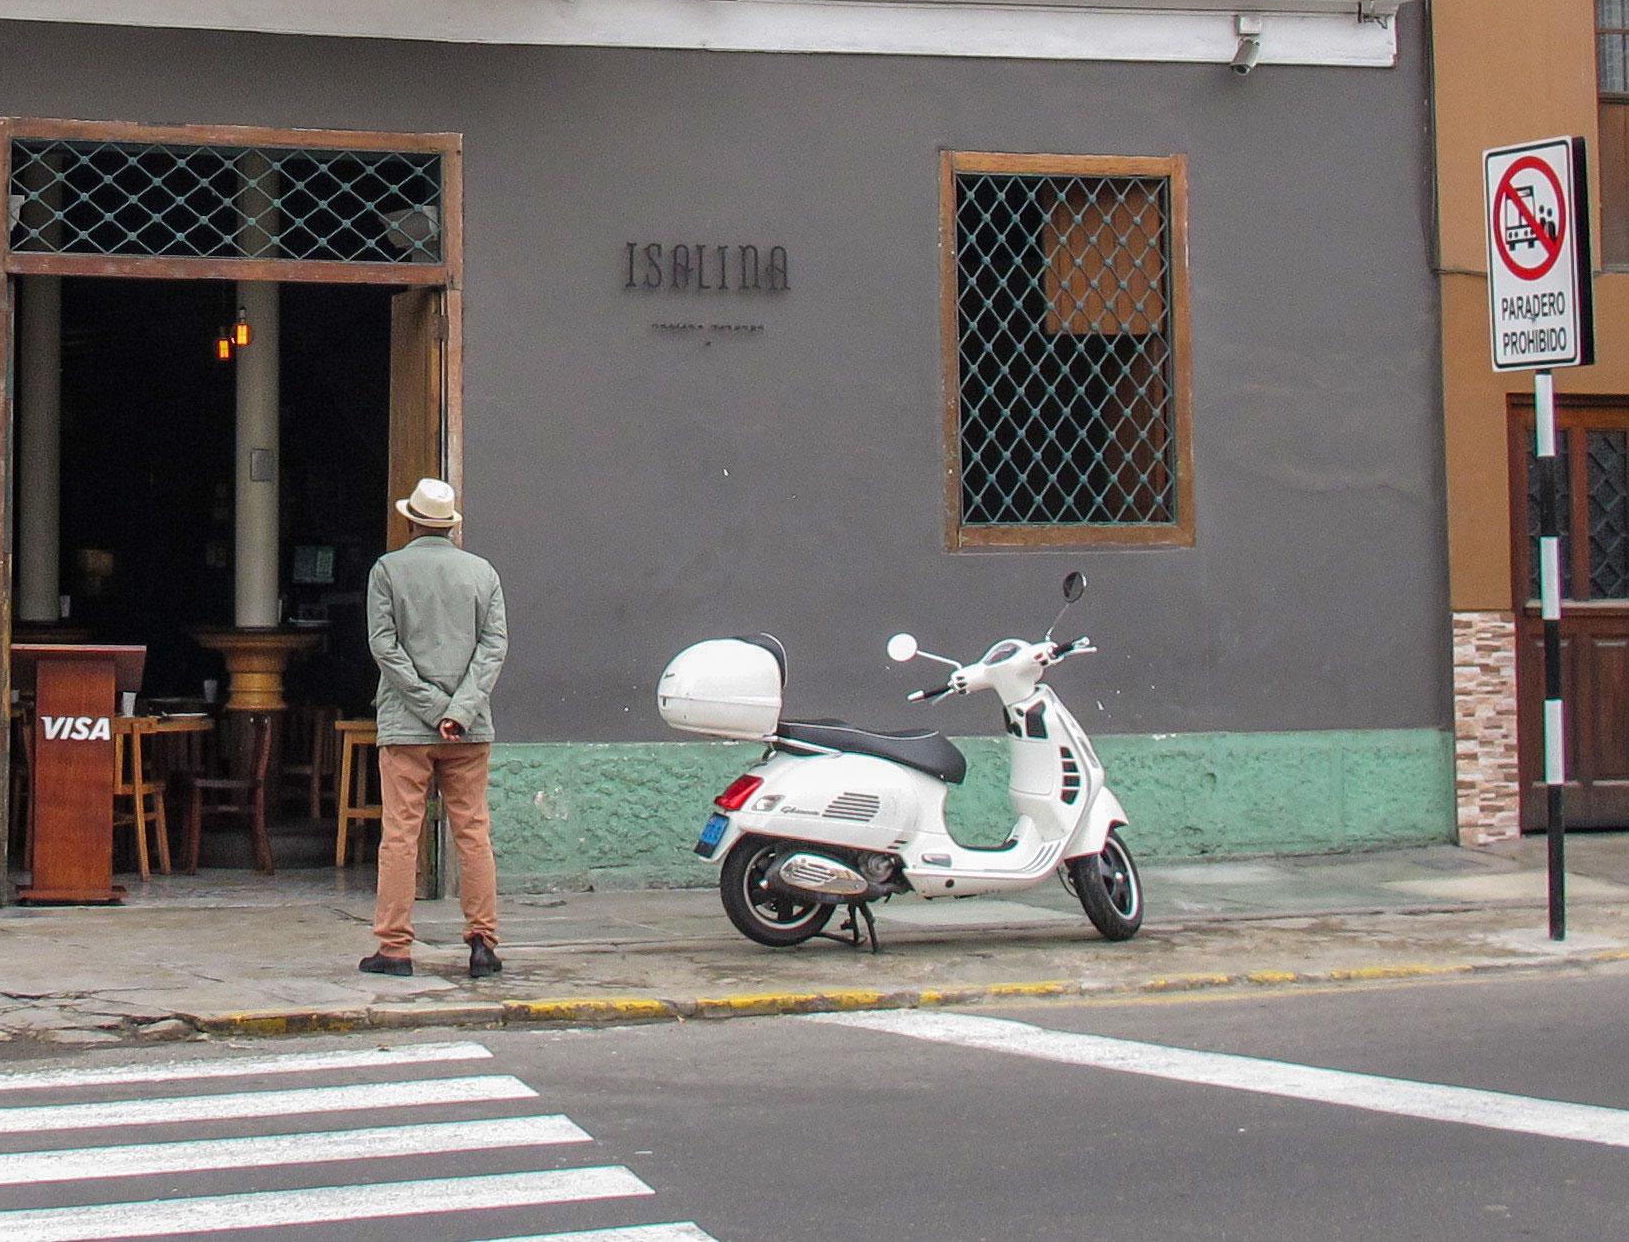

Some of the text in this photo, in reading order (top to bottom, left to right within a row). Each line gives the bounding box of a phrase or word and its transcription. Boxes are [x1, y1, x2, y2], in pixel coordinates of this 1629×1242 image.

[1502, 291, 1566, 320] PARADERO
[1503, 327, 1567, 356] PROHIBIDO
[41, 715, 111, 741] VISA
